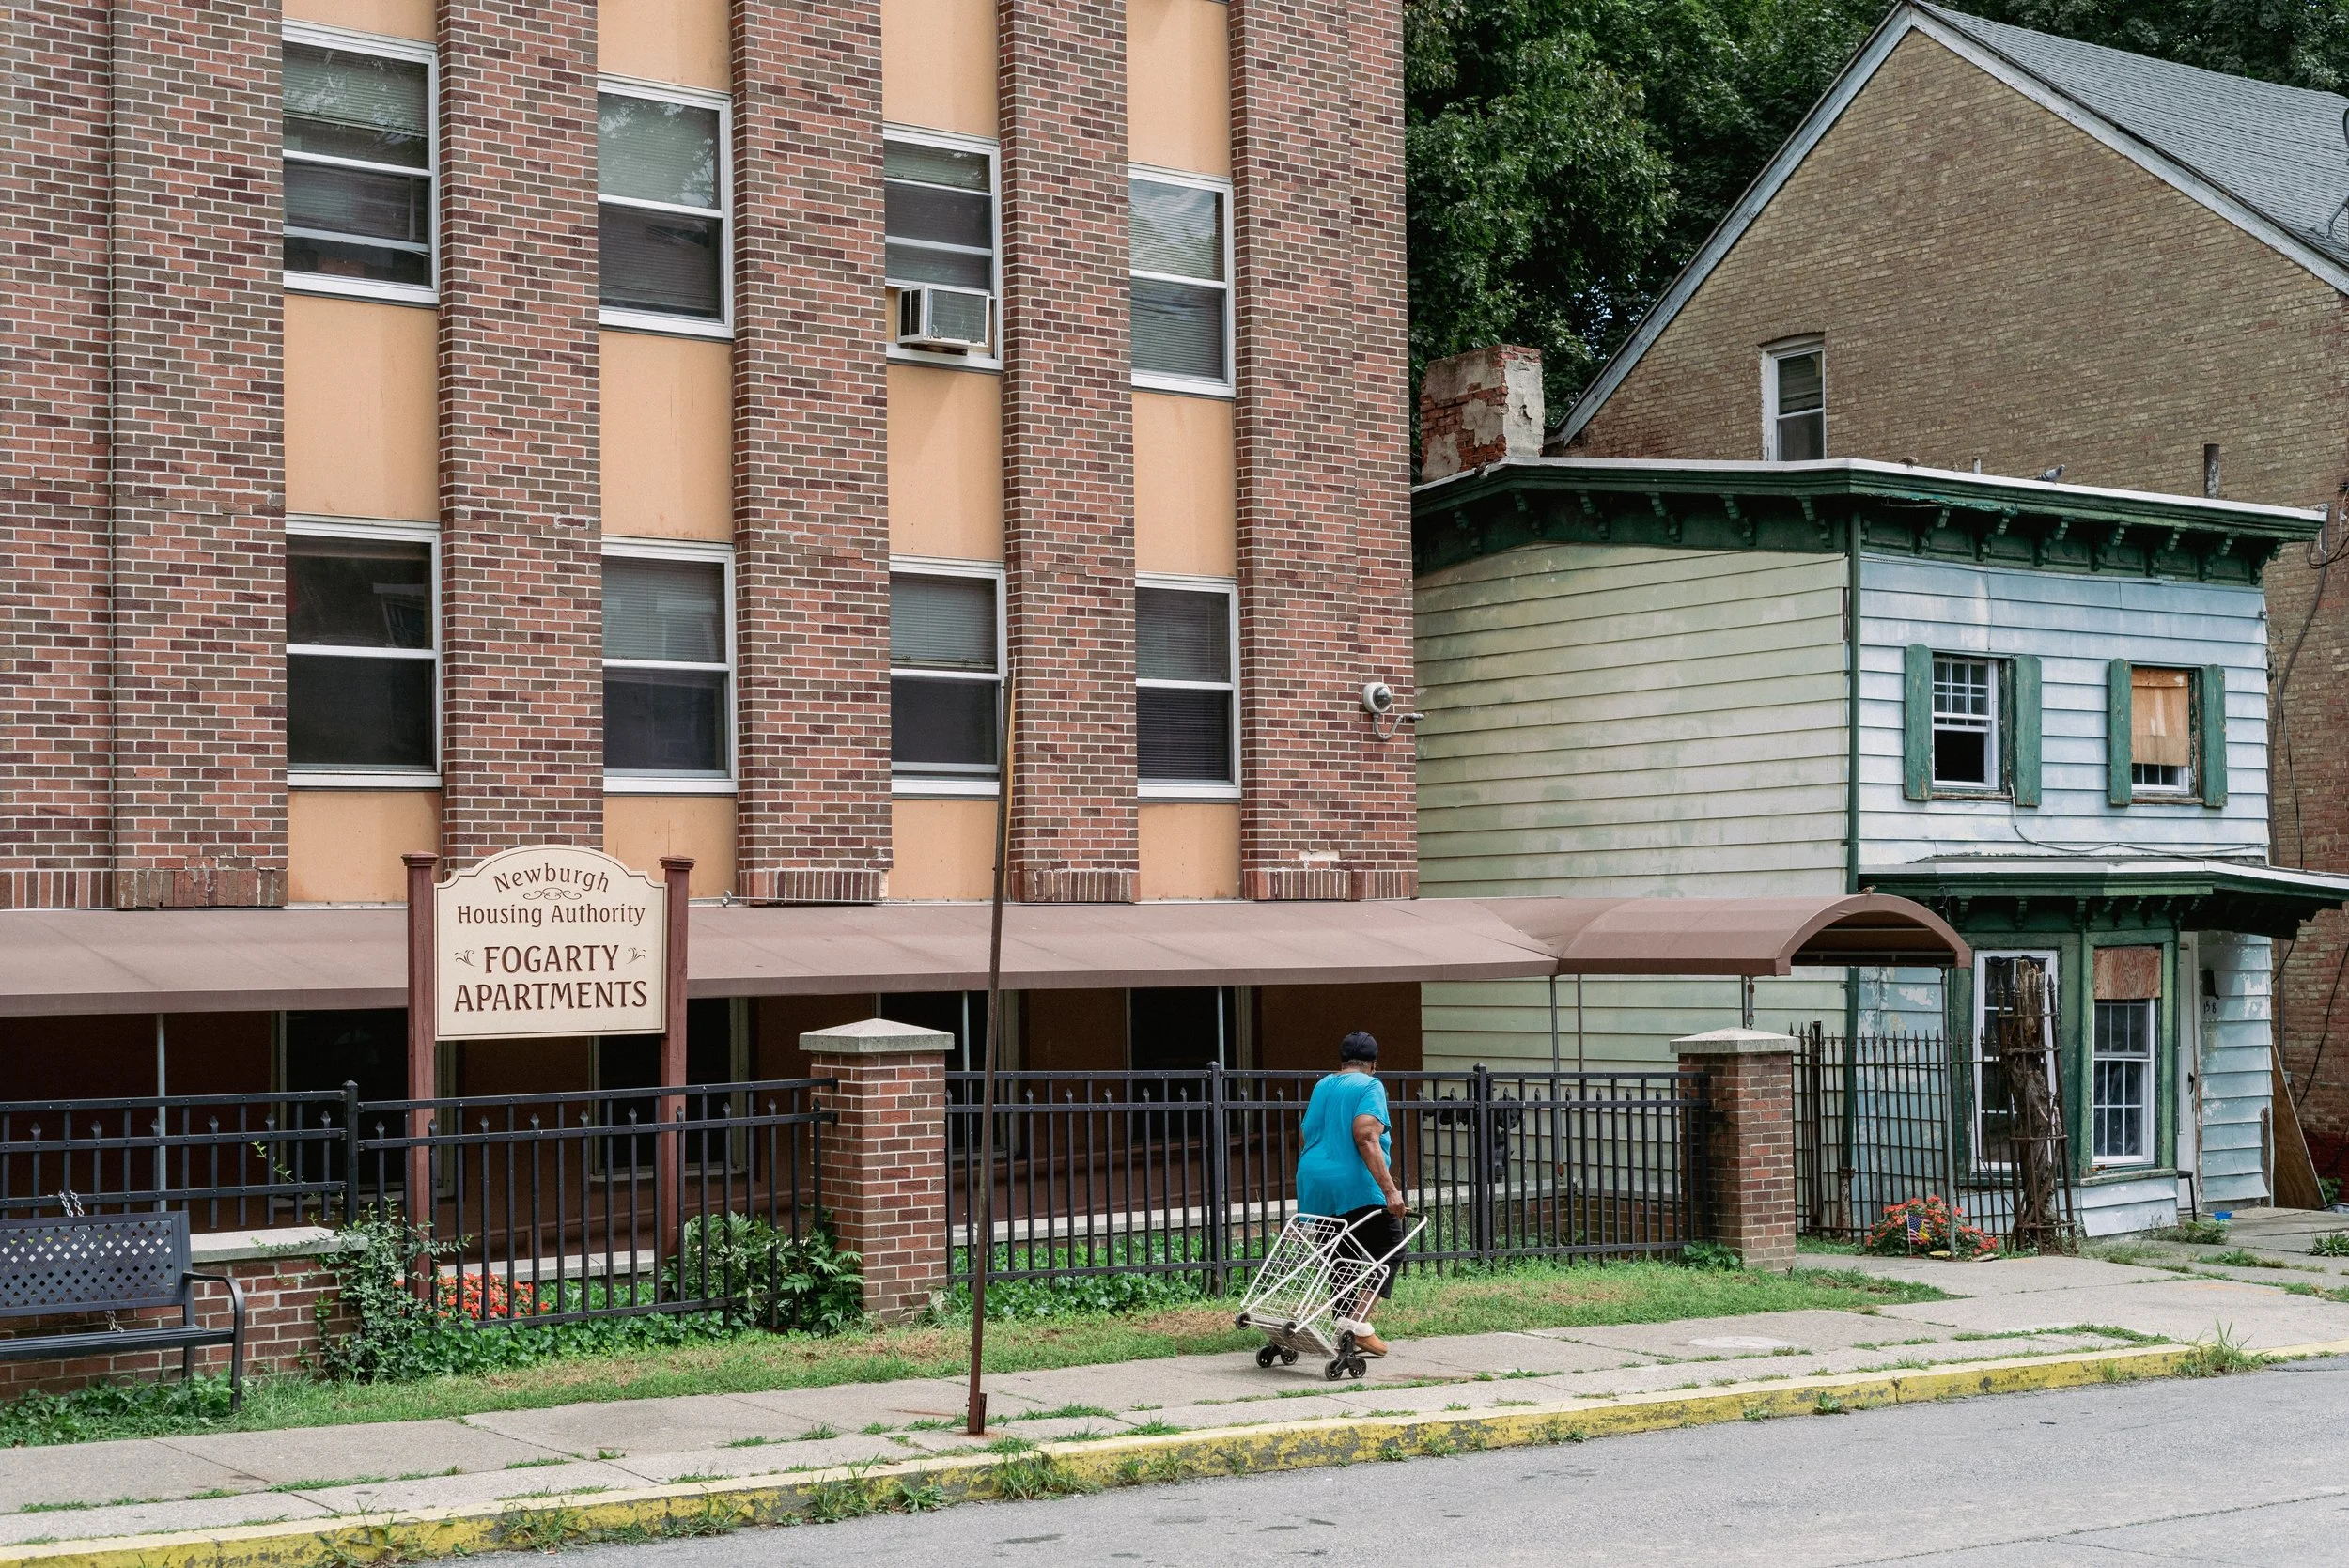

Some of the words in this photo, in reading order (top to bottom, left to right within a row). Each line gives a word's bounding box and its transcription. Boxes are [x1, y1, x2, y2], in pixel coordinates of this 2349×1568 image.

[493, 863, 609, 893] Newburgh
[458, 904, 542, 927] Housing
[552, 903, 646, 926] Authority
[484, 944, 619, 973] FOGARTY
[454, 980, 647, 1013] APARTMENTS
[2203, 1001, 2217, 1014] 158
